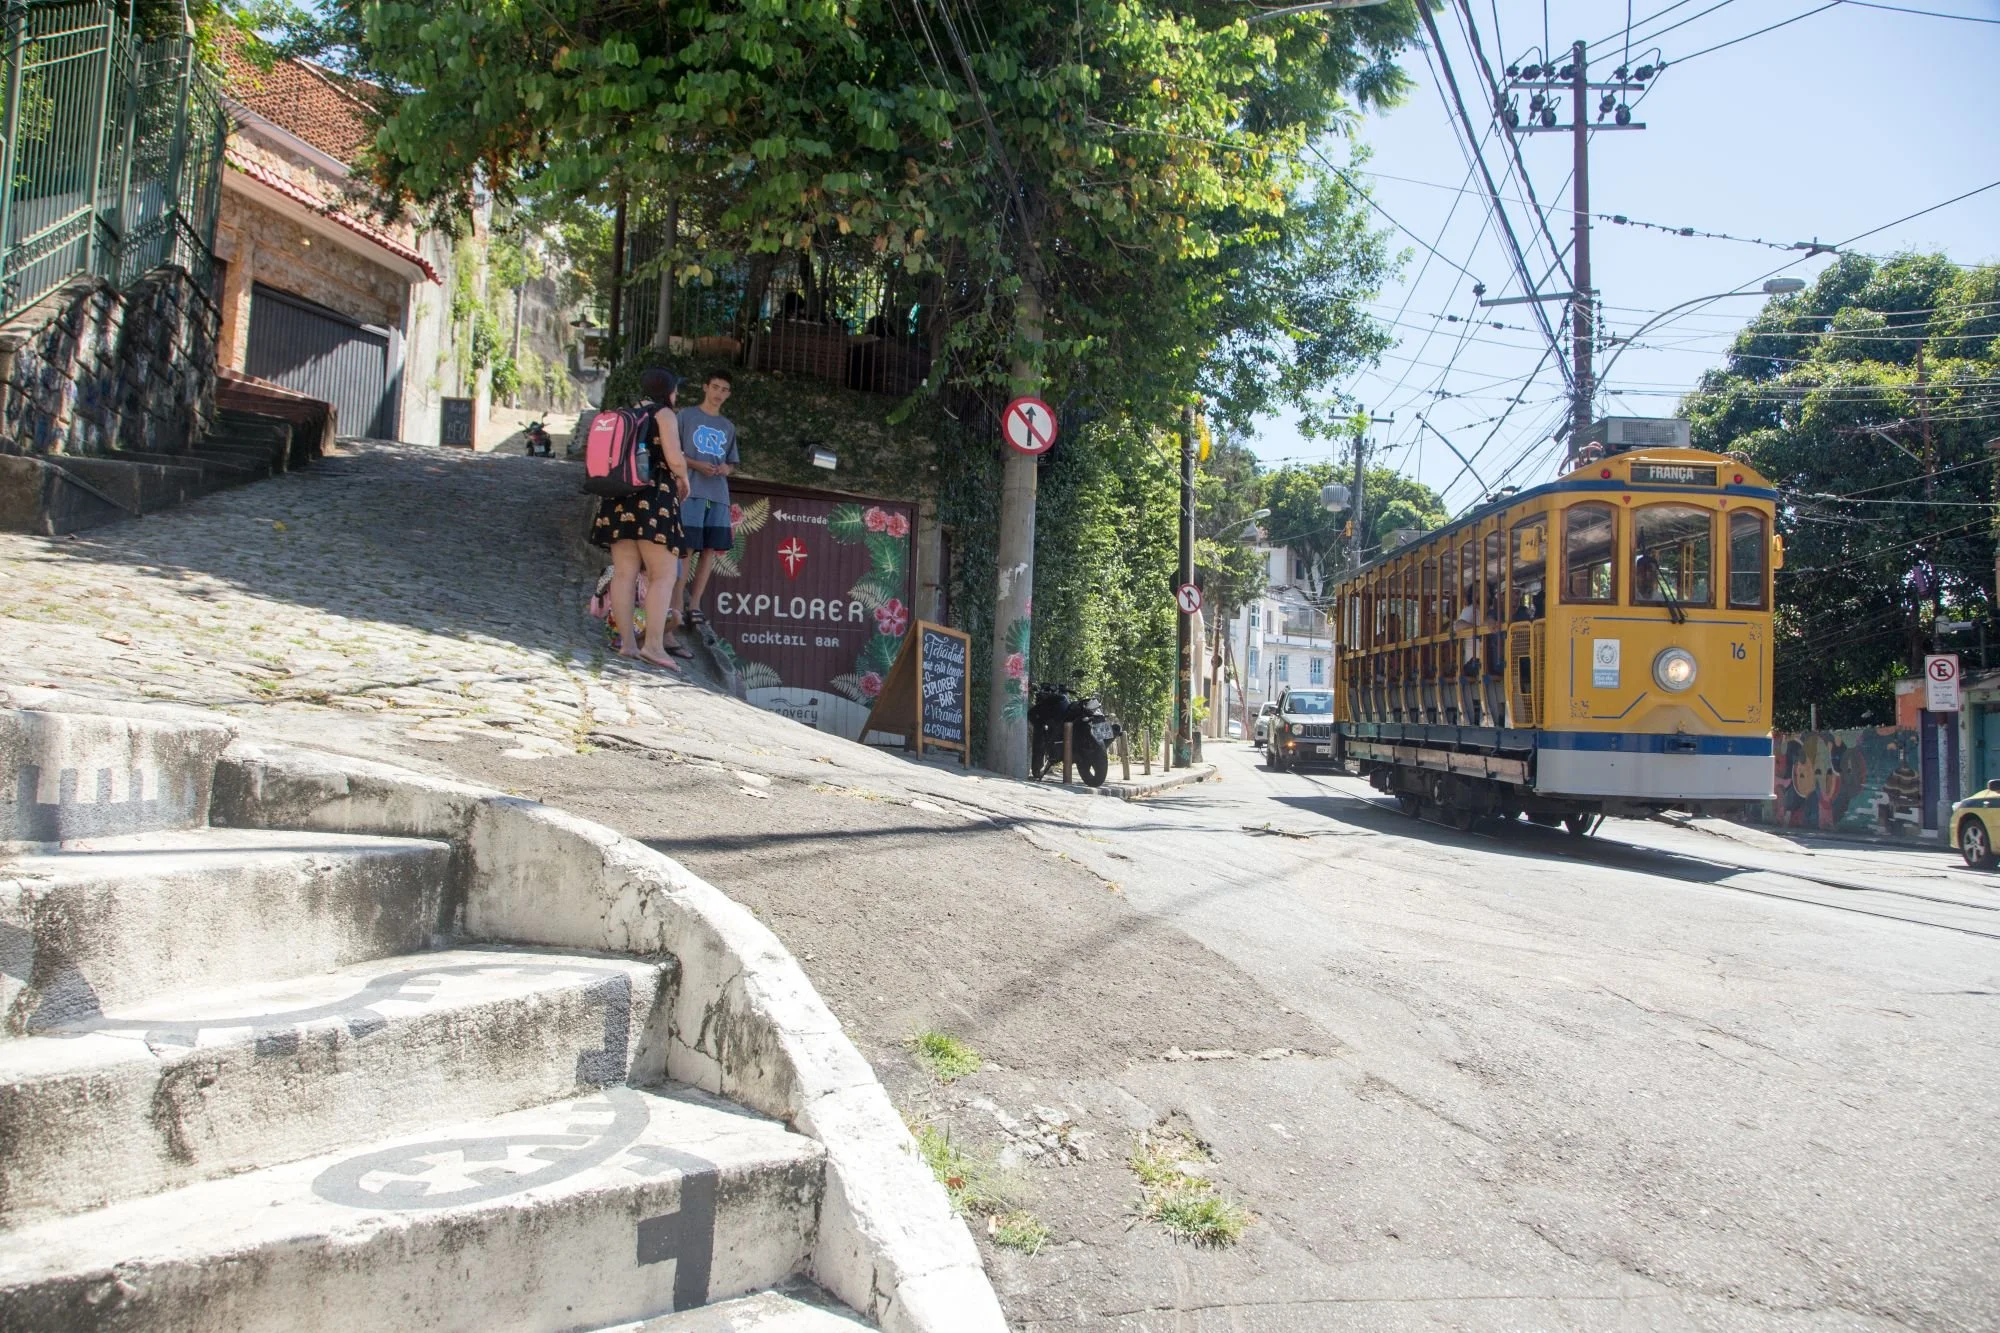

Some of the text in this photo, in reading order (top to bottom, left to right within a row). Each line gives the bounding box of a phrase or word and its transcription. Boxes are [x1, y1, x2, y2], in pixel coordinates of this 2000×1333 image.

[1649, 465, 1694, 483] FRANÇA
[791, 514, 827, 525] entrada
[717, 592, 864, 623] EXPLORER
[1730, 642, 1746, 660] 16
[922, 676, 958, 698] EXPLORER
[938, 690, 956, 708] BAR
